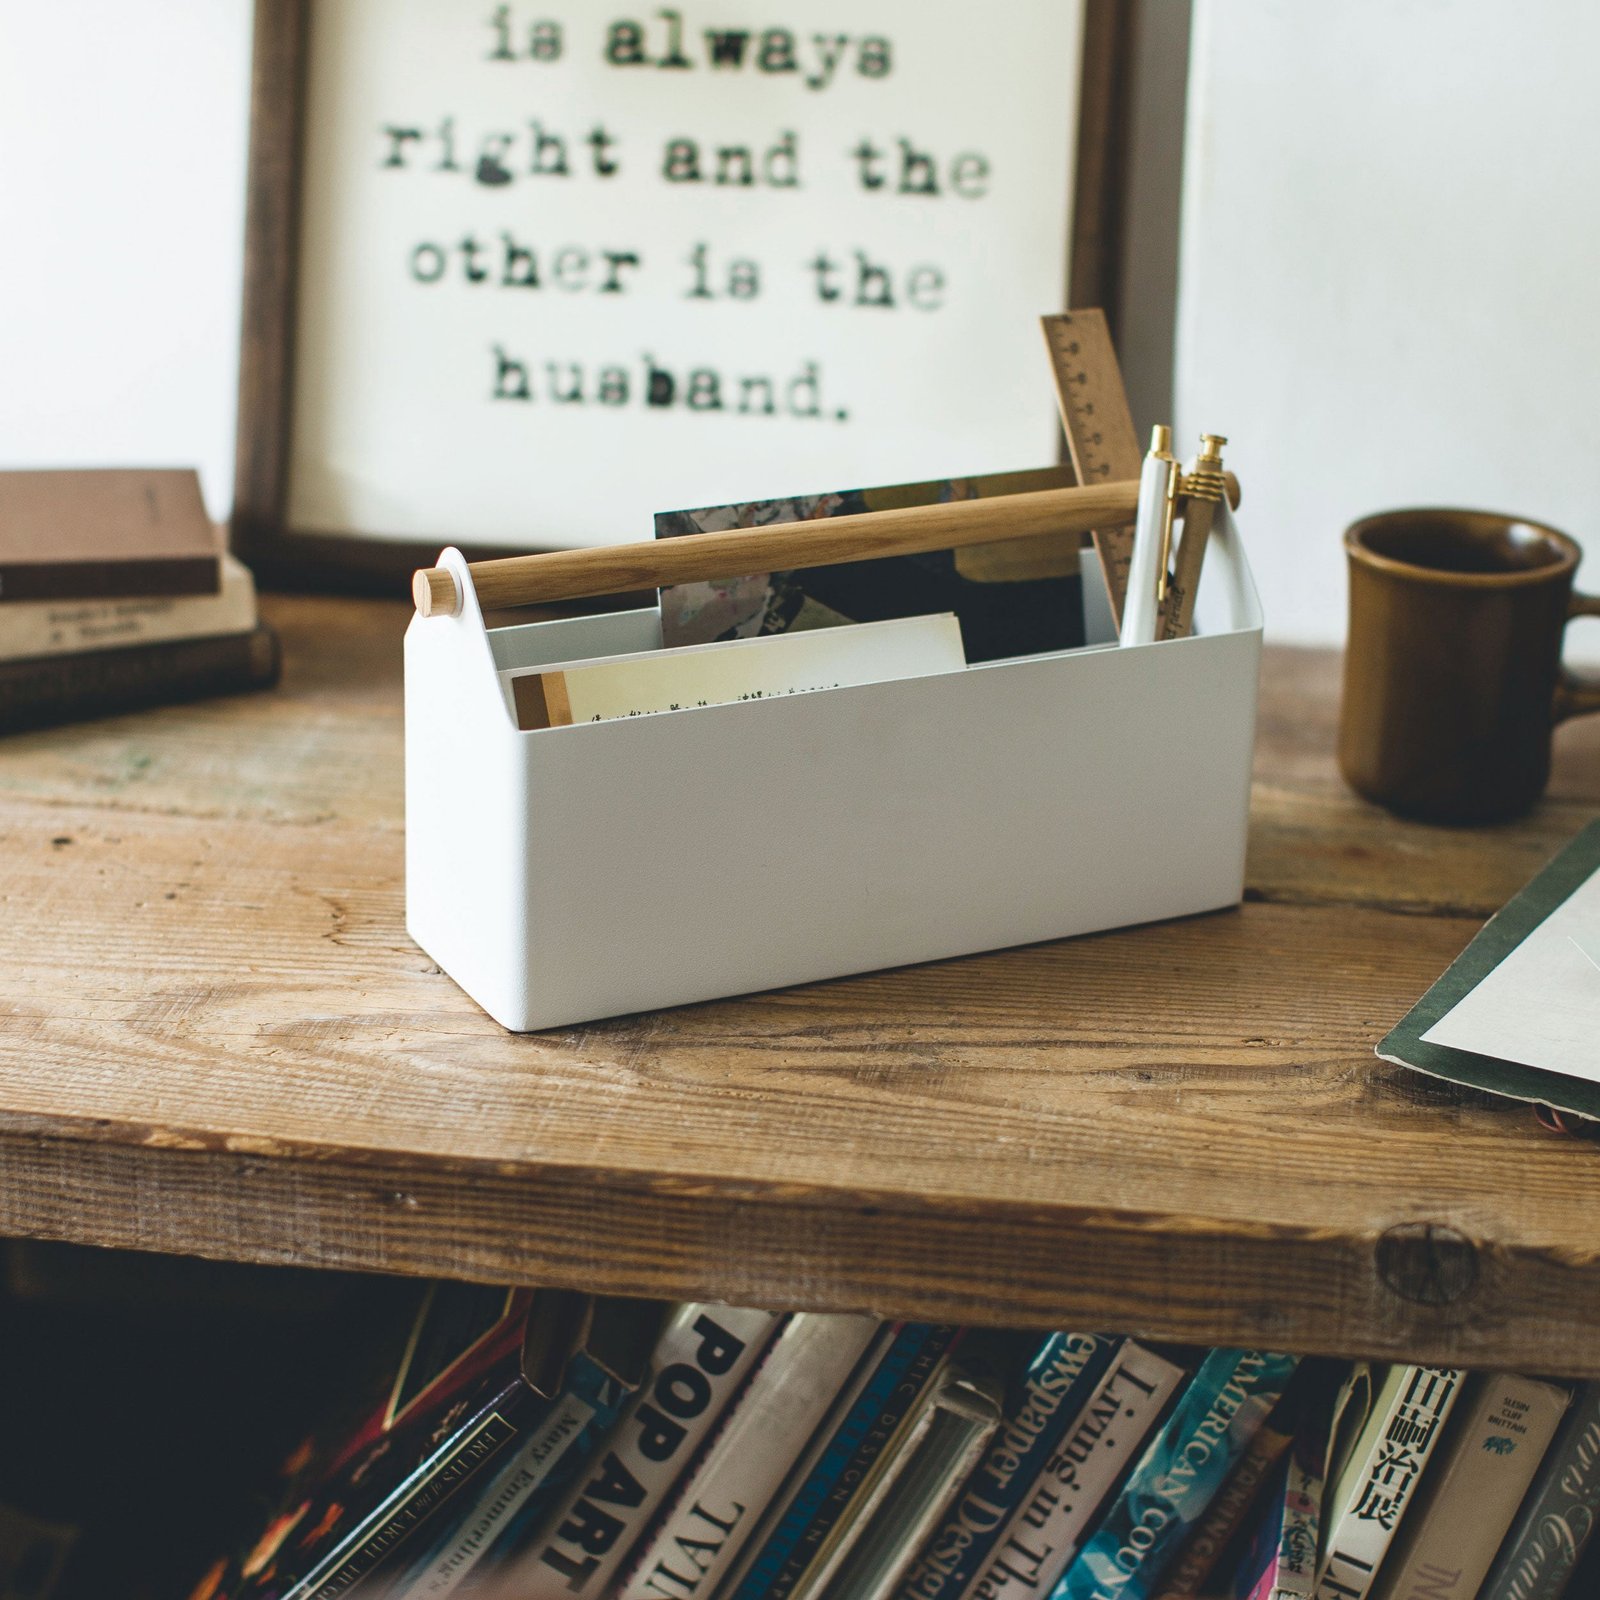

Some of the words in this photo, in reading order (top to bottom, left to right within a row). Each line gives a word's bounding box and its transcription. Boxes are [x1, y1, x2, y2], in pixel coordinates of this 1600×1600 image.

[485, 6, 563, 62] is
[603, 10, 896, 90] always
[378, 116, 621, 188] right
[660, 130, 806, 190] and
[851, 134, 992, 199] the
[408, 231, 640, 294] other
[683, 241, 761, 301] is
[808, 249, 947, 312] the
[488, 343, 850, 423] husband.
[636, 1313, 747, 1463] POP
[1045, 1363, 1160, 1491] Living
[1156, 1349, 1268, 1500] AMERICAN
[443, 1431, 497, 1482] FRUITS
[532, 1412, 580, 1466] Mary
[832, 1414, 897, 1502] DESIGN
[1350, 1364, 1458, 1531] 田嗣治展
[363, 1508, 418, 1560] EARTH
[432, 1467, 536, 1589] Emmerling's
[538, 1450, 648, 1593] ART
[805, 1519, 833, 1543] IN
[1023, 1486, 1074, 1532] in
